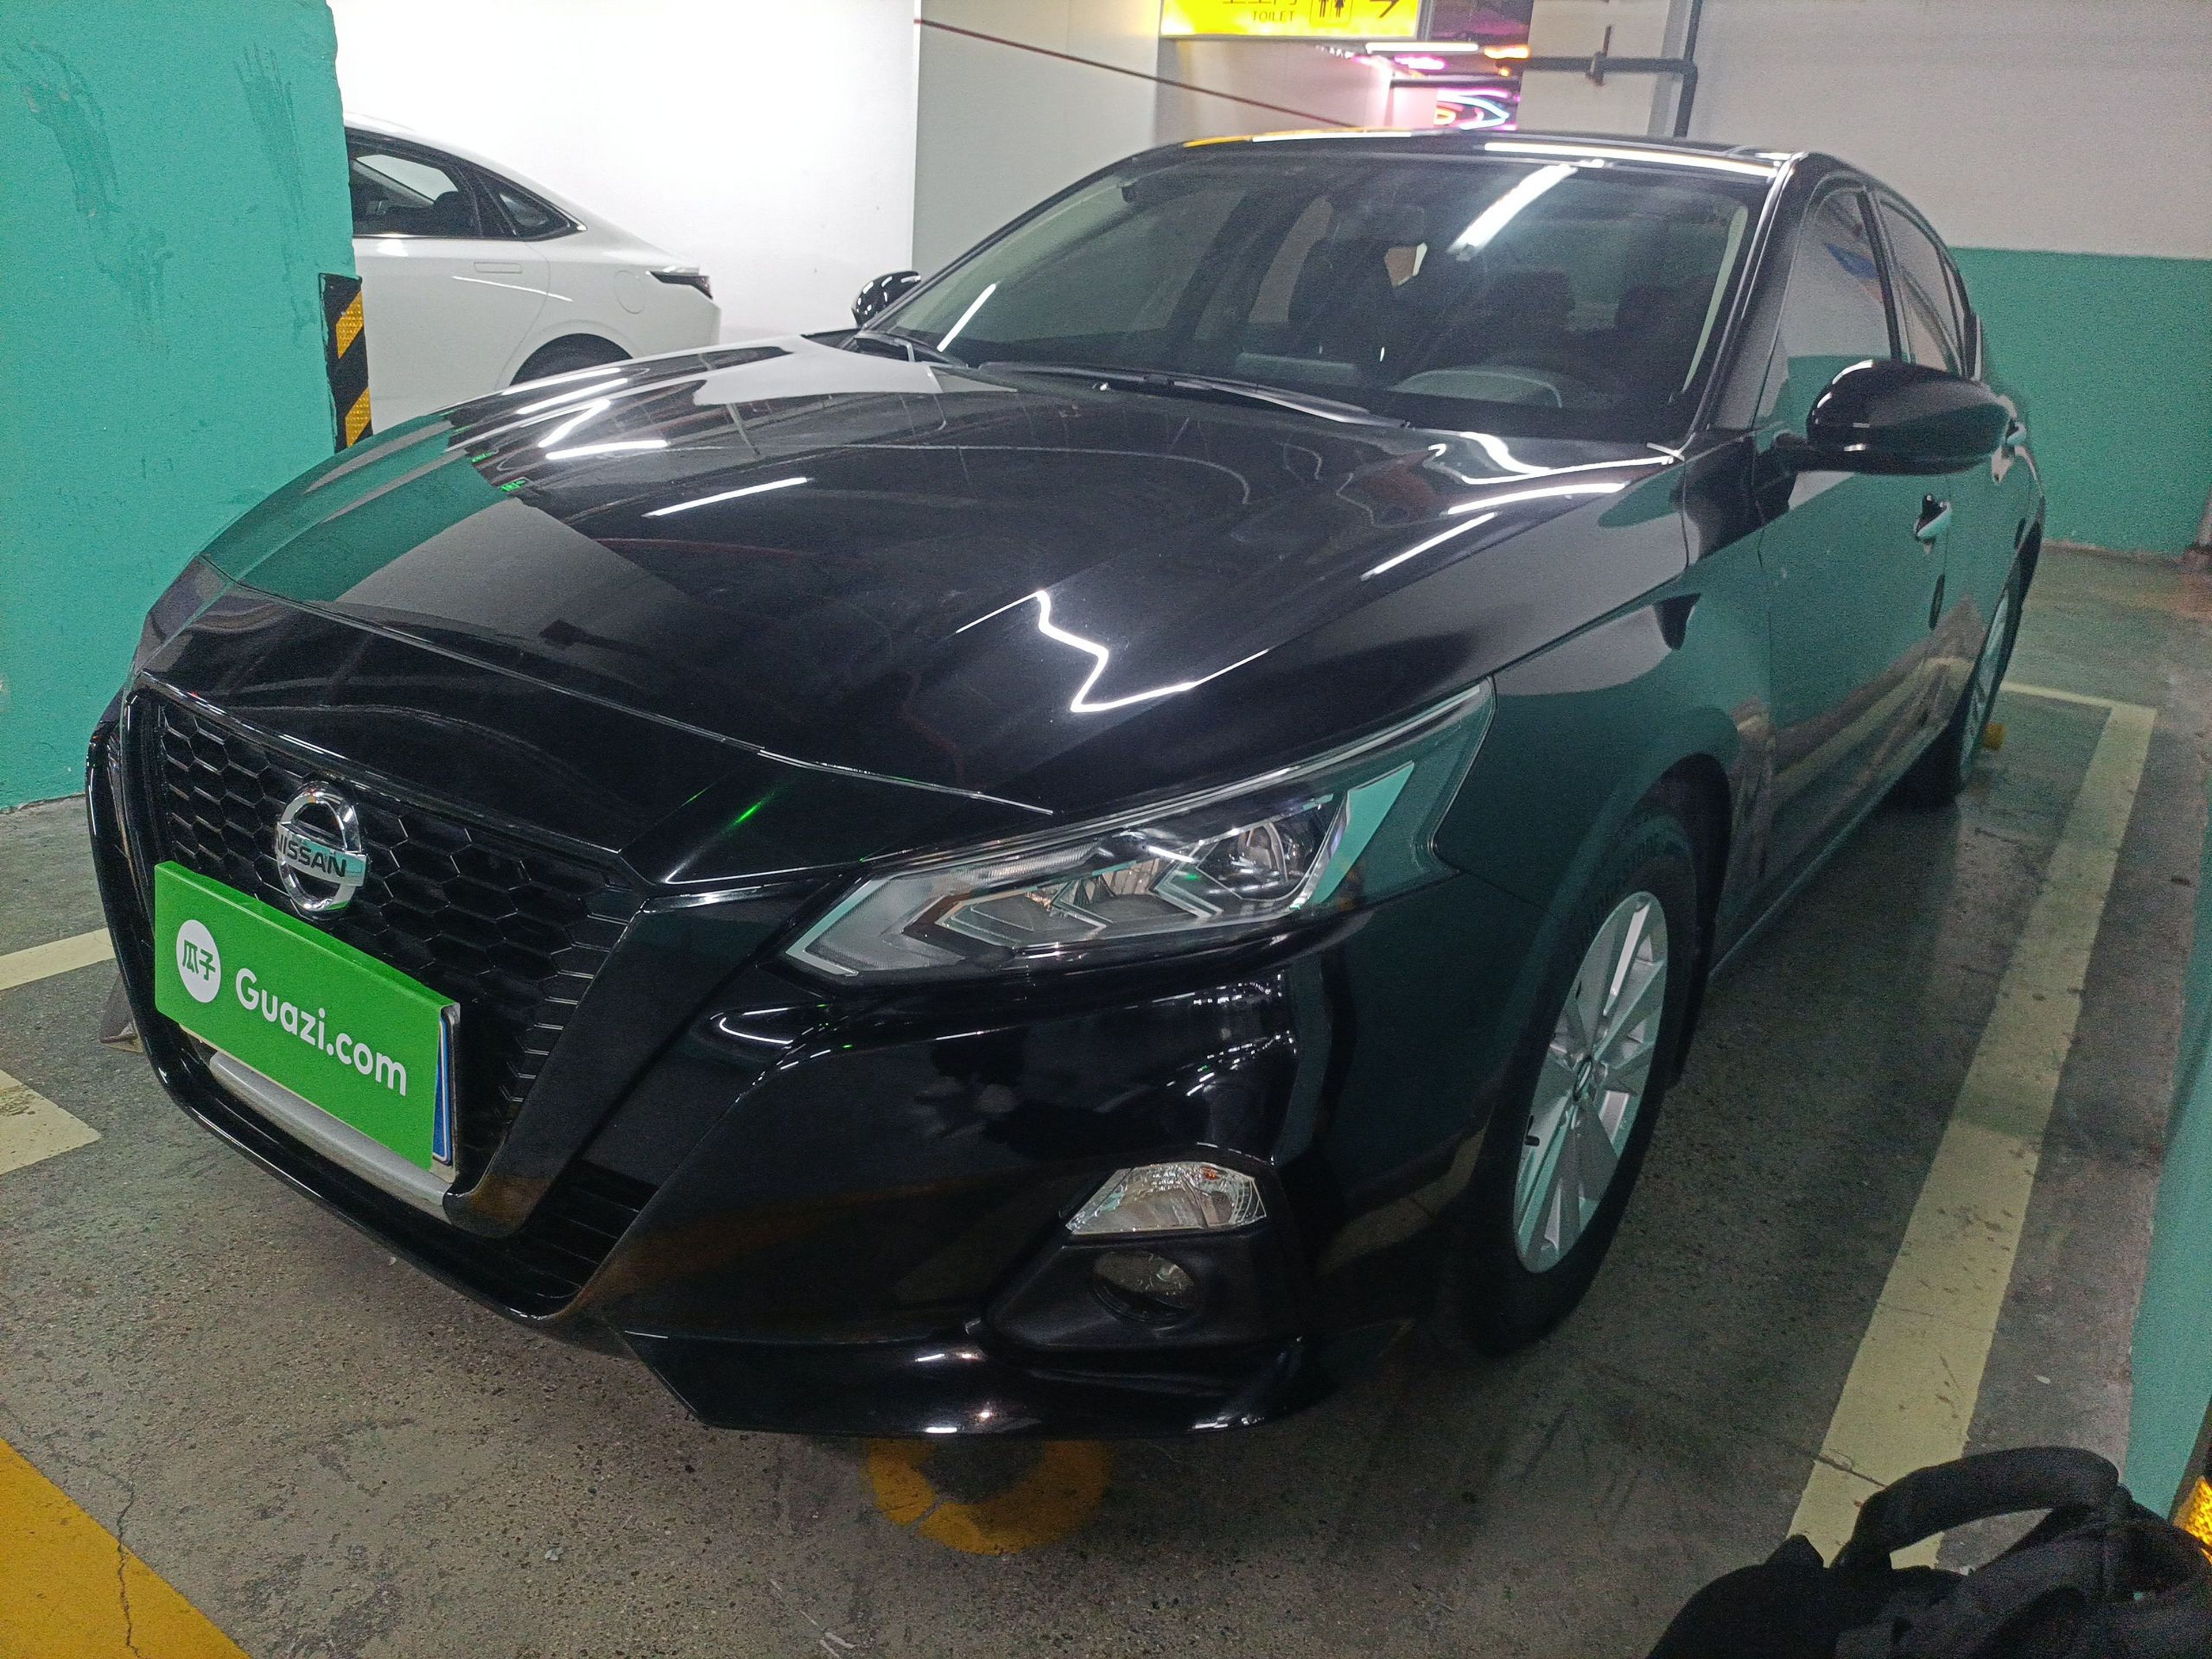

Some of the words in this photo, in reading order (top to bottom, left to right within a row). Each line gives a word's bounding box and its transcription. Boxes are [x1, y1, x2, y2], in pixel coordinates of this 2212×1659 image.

[1253, 10, 1294, 22] TOILET
[276, 831, 347, 877] NISSAN
[181, 939, 216, 981] 瓜子
[236, 968, 407, 1096] Guazi.com
